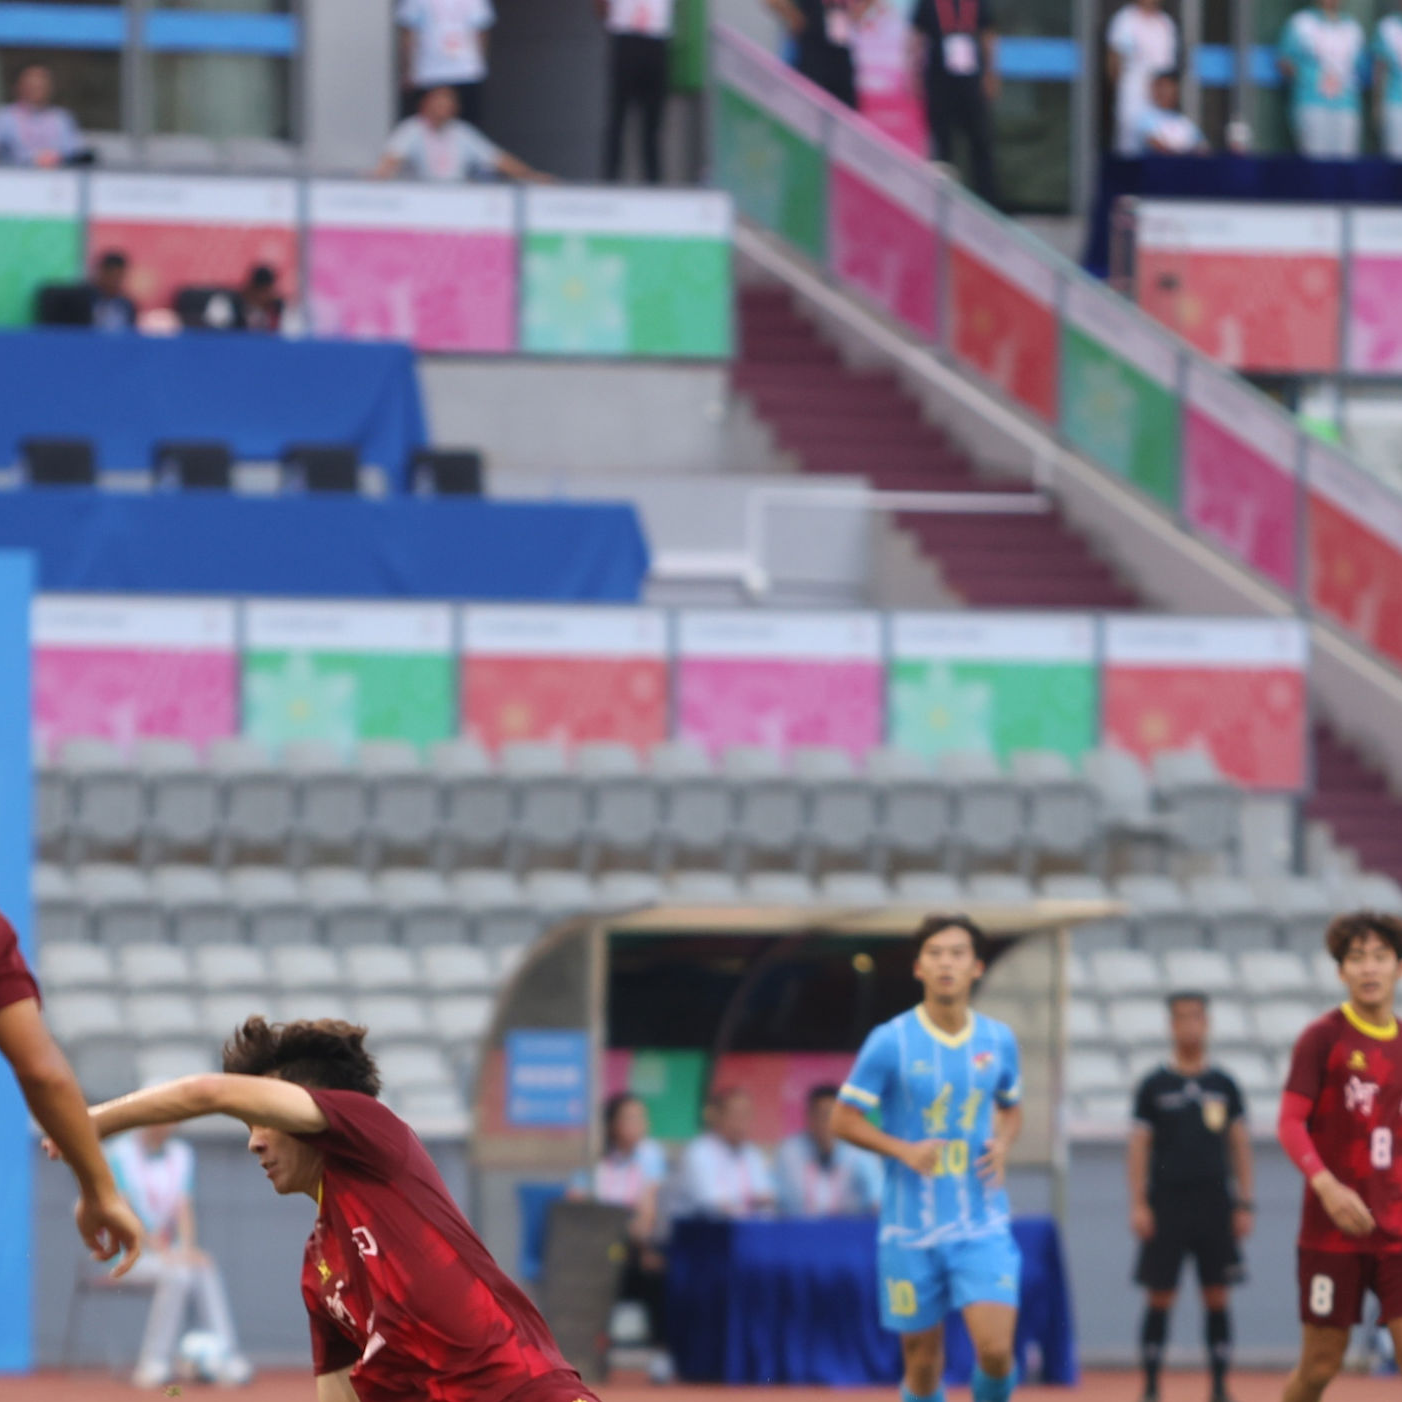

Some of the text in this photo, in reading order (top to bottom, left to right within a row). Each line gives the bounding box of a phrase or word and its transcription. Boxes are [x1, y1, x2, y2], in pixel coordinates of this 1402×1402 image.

[1370, 1127, 1393, 1170] 8
[886, 1276, 918, 1317] 10
[1309, 1273, 1334, 1317] 8
